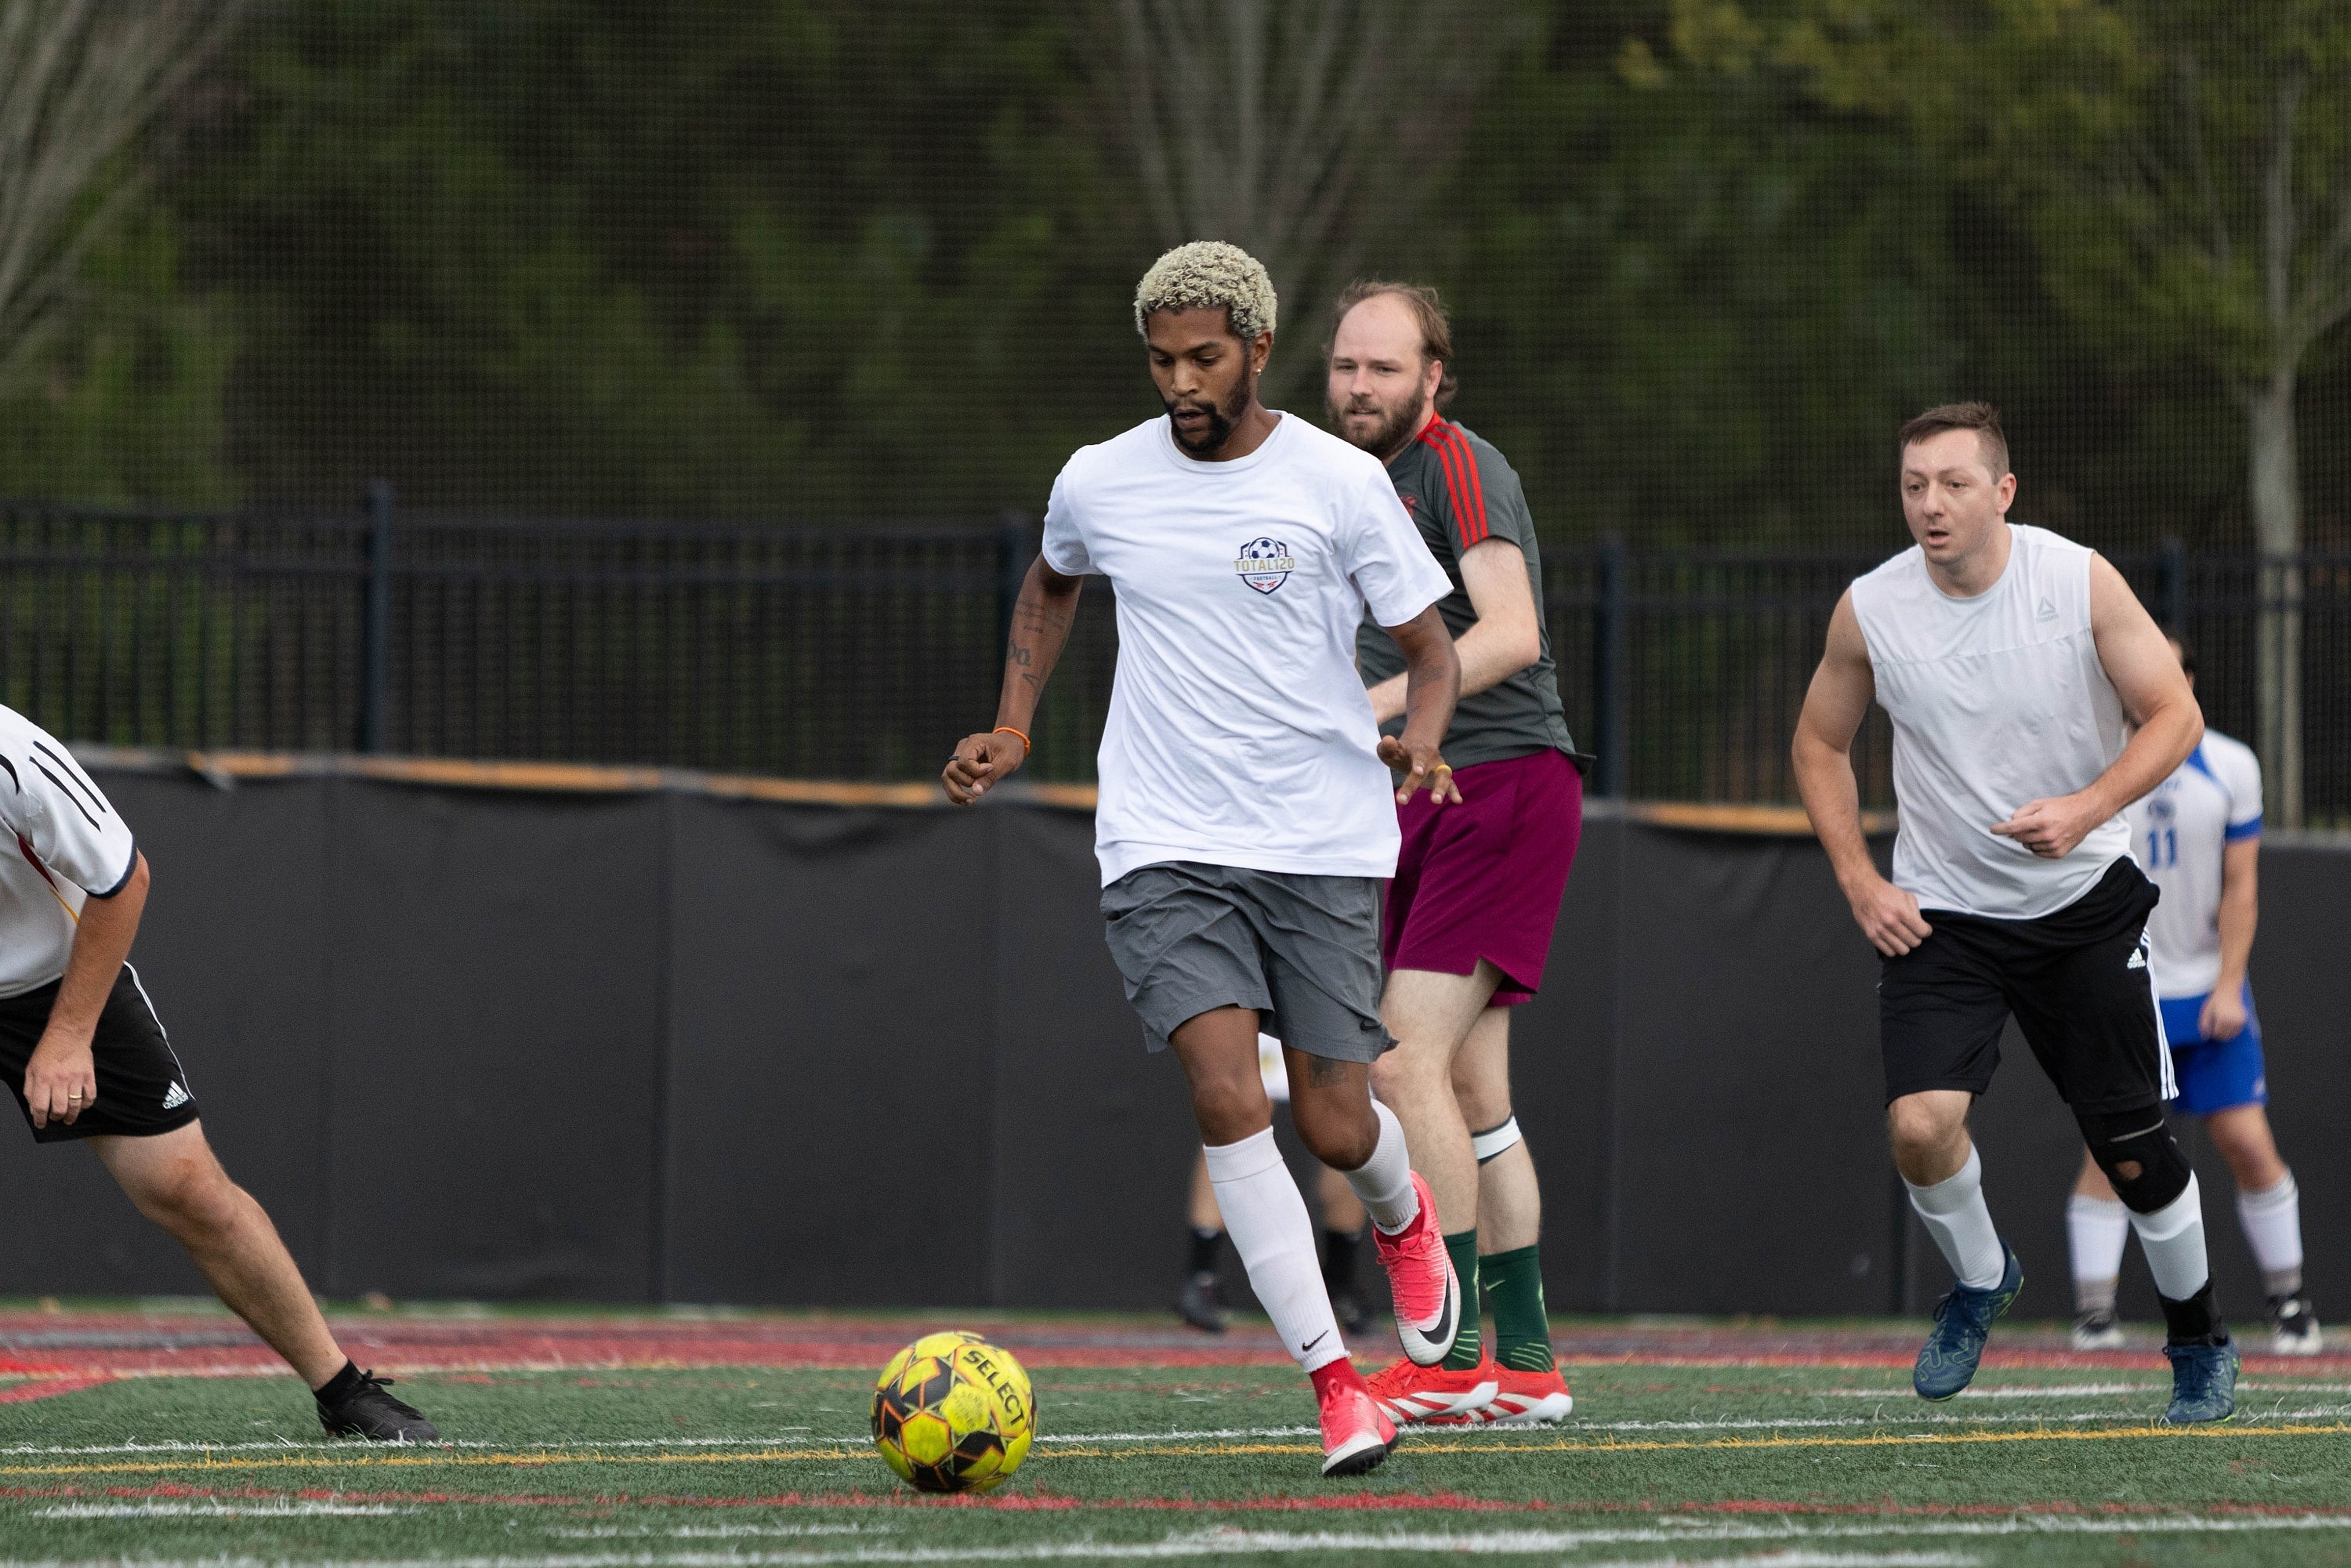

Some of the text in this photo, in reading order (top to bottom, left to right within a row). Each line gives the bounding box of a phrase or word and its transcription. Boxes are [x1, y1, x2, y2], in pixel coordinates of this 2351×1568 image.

[1233, 557, 1295, 572] TOTAL120
[2147, 827, 2178, 869] 11
[162, 1092, 189, 1110] adidas
[962, 1349, 1025, 1425] SELECT
